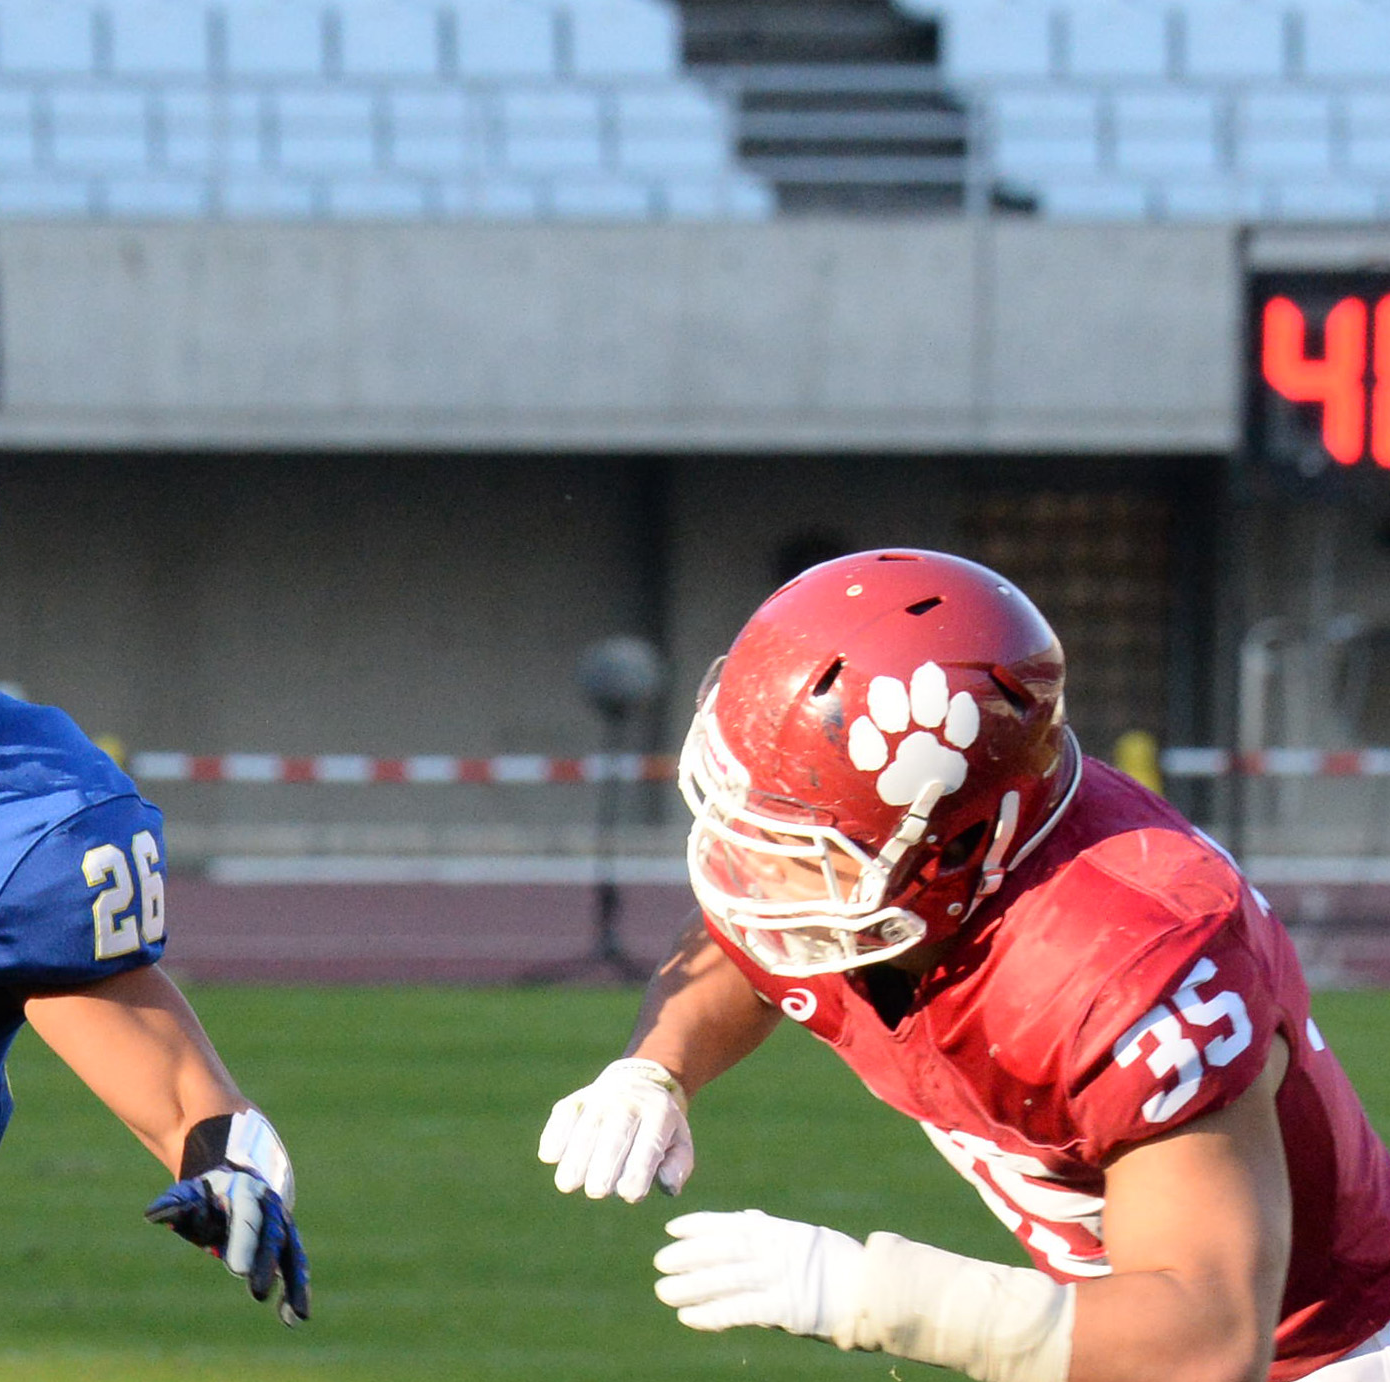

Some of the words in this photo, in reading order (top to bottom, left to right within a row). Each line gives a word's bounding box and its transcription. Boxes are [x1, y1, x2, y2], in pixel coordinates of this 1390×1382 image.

[1262, 294, 1390, 468] 4
[81, 829, 165, 961] 26
[1111, 955, 1253, 1123] 35
